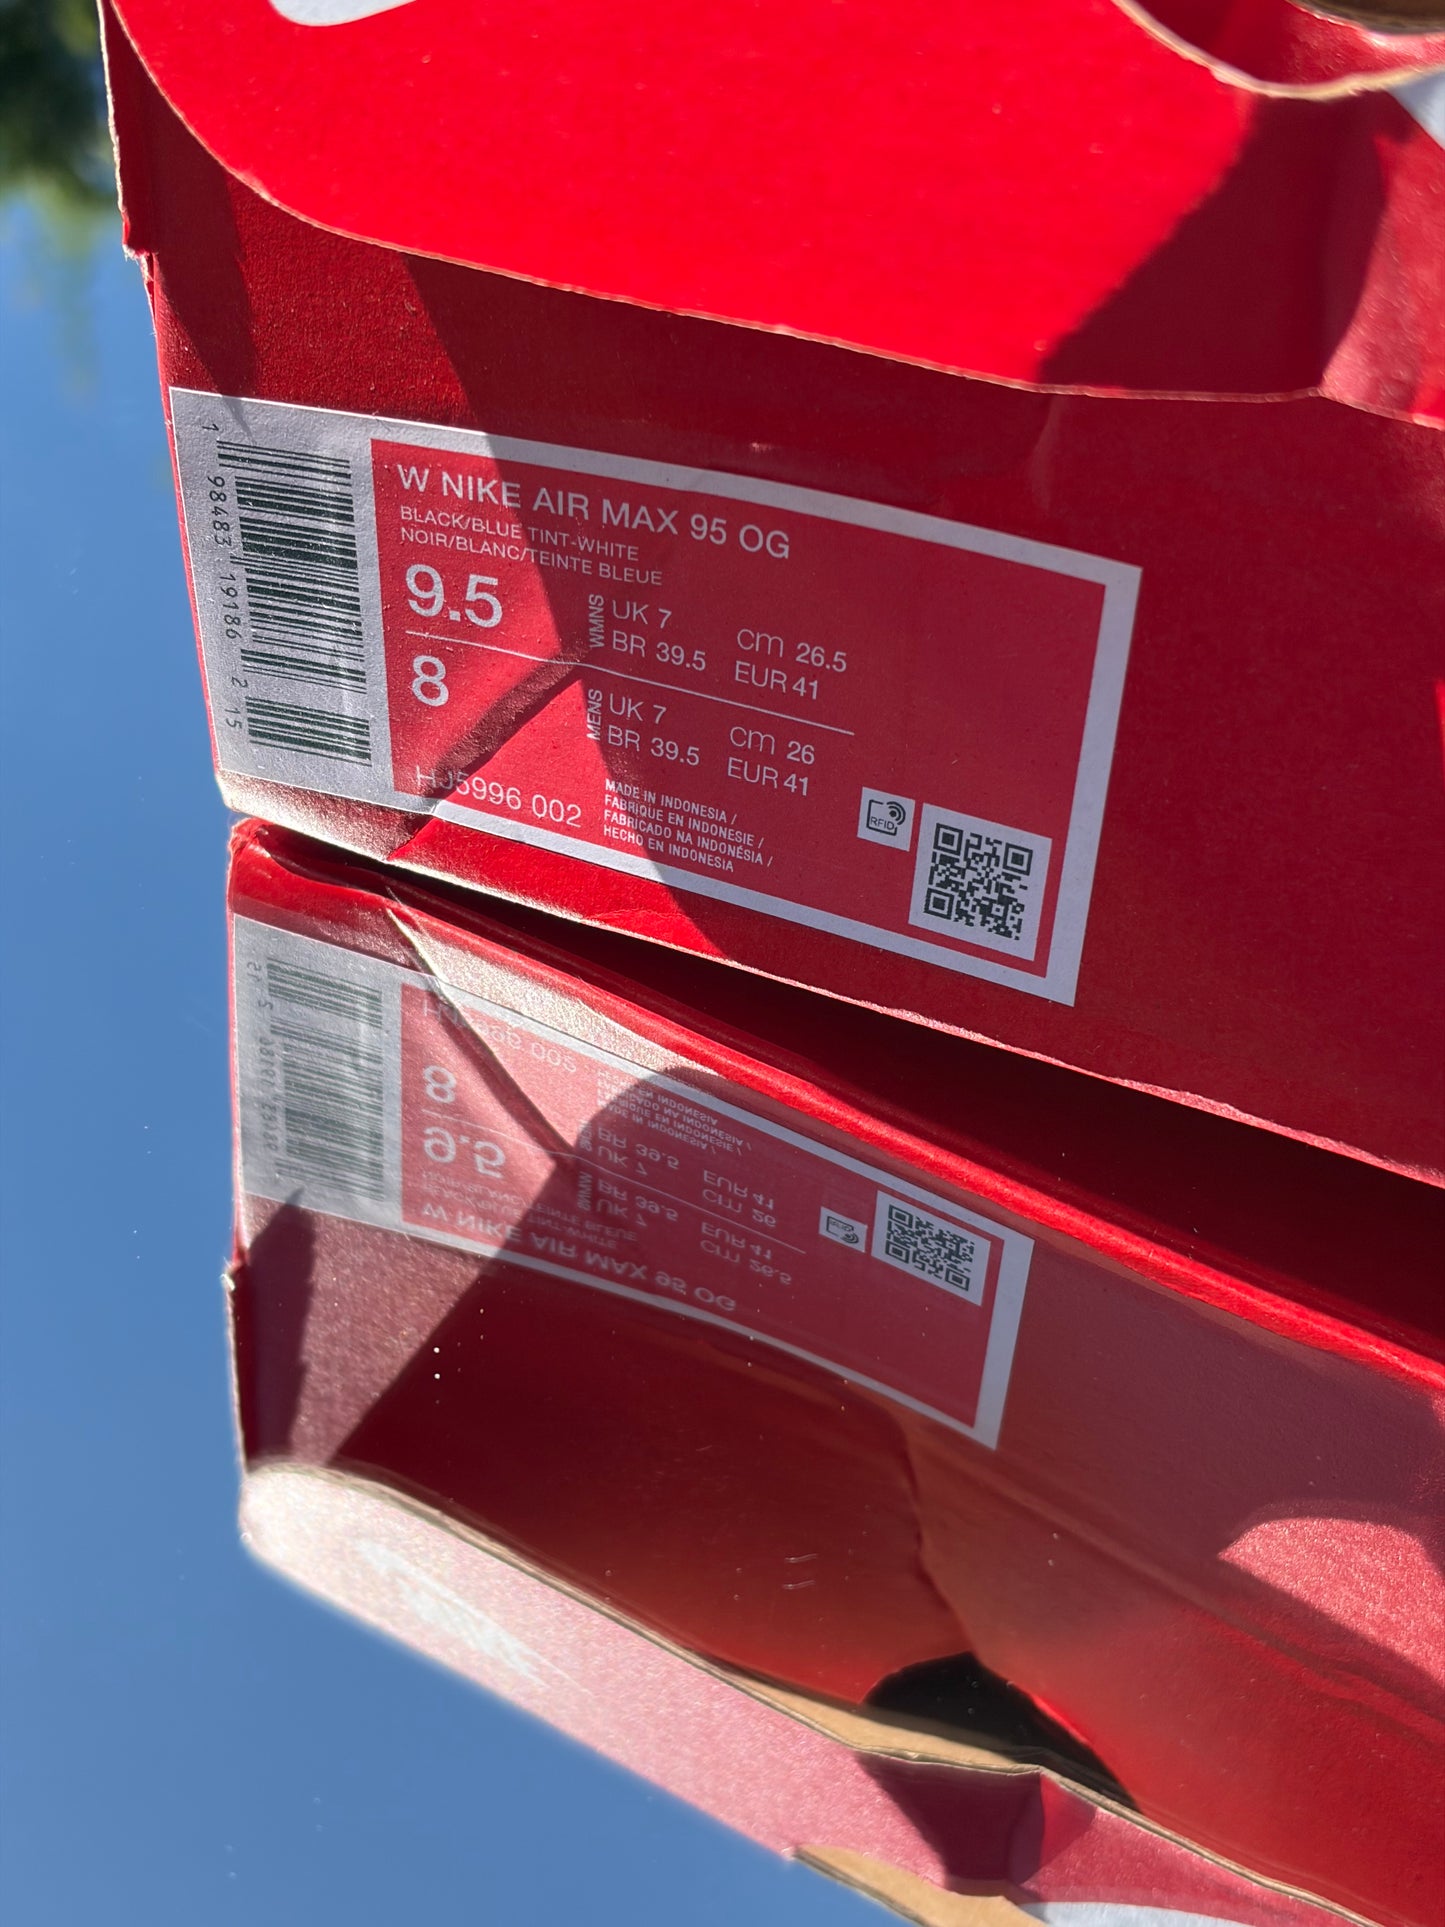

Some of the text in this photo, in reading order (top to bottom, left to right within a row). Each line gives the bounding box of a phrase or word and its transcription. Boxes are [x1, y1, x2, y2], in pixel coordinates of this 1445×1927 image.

[397, 464, 790, 559] W NIKE AIR MAX 95 OG
[400, 505, 639, 562] BLACK/BLUE TINT-WHITE
[202, 423, 248, 689] 1 98483 19186 2
[401, 527, 663, 586] NOIR/BLANC/TEINTE BLEUE
[405, 563, 503, 628] 9.5
[612, 599, 672, 629] UK 7
[589, 593, 605, 648] WMNS
[612, 630, 706, 671] BR 39.5
[795, 642, 847, 673] 26.5
[412, 655, 449, 707] 8
[735, 660, 818, 700] EUR 41
[225, 707, 242, 730] 15
[586, 689, 603, 741] MENS
[609, 693, 666, 724] UK 7
[608, 724, 700, 766] BR 39.5
[786, 740, 815, 765] 26
[416, 765, 581, 828] HJ5996 002
[727, 756, 809, 796] EUR 41
[605, 778, 640, 799] MADE
[644, 790, 656, 803] IN
[661, 794, 727, 823] INDONESIA
[605, 794, 663, 822] FABRIQUE
[668, 809, 684, 827] EN
[688, 816, 754, 847] INDONESIE
[870, 816, 895, 830] RFID
[603, 825, 734, 873] HECHO EN INDONESIA
[604, 810, 672, 839] FABRICADO
[676, 827, 693, 845] NA
[697, 836, 763, 865] INDONÉSIA
